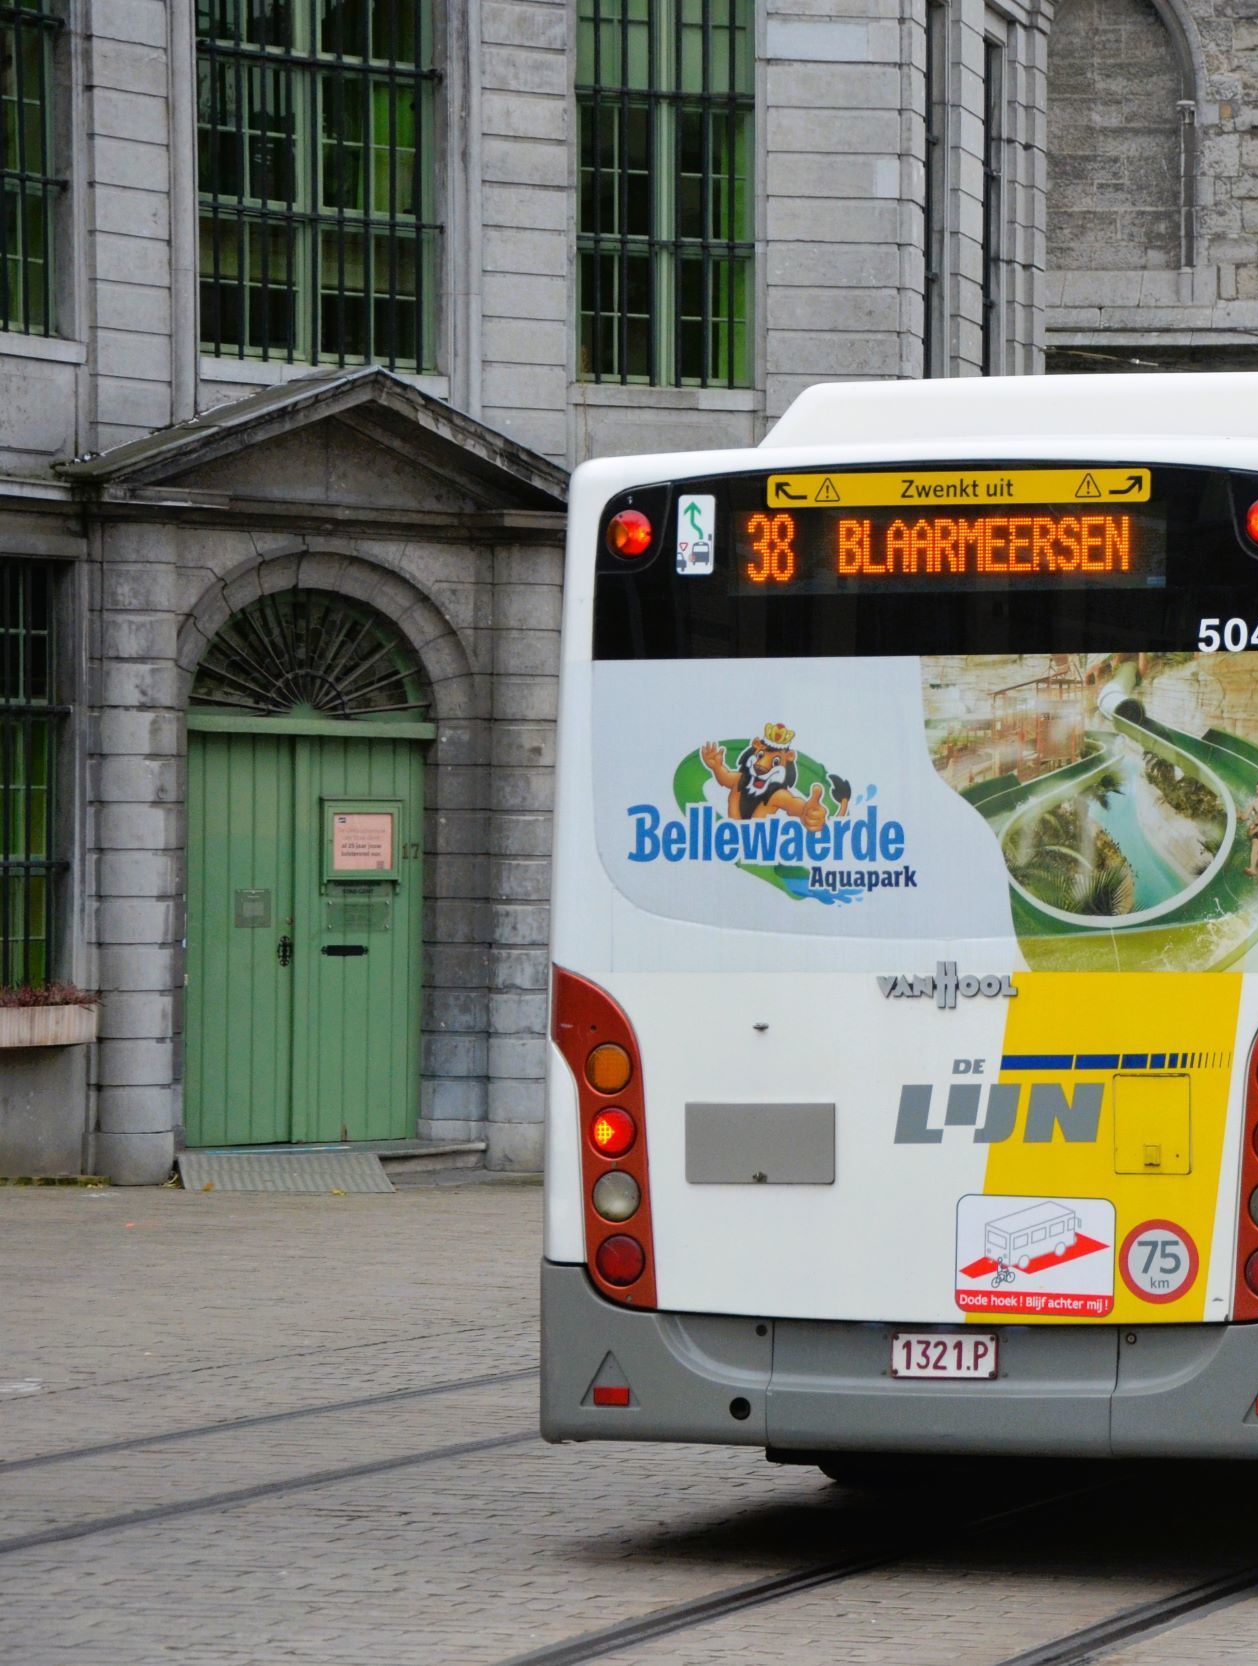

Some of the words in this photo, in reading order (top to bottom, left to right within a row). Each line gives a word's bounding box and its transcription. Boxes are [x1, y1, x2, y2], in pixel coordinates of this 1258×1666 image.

[900, 479, 978, 499] Zwenkt
[986, 478, 1015, 498] uit
[747, 514, 795, 582] 38
[838, 516, 1130, 575] BLAARMEERSEN
[626, 804, 906, 863] Bellewaerde
[402, 843, 420, 860] 17
[809, 866, 918, 892] Aquapark
[952, 1059, 985, 1074] DE
[894, 1083, 1105, 1144] LIJN
[1137, 1240, 1181, 1274] 75
[1150, 1277, 1170, 1289] km
[959, 1294, 988, 1306] Dode
[990, 1294, 1018, 1307] hoek
[1025, 1295, 1047, 1309] Blijf
[1047, 1297, 1084, 1310] achter
[1086, 1299, 1103, 1312] mij
[901, 1340, 990, 1371] 1321.P
